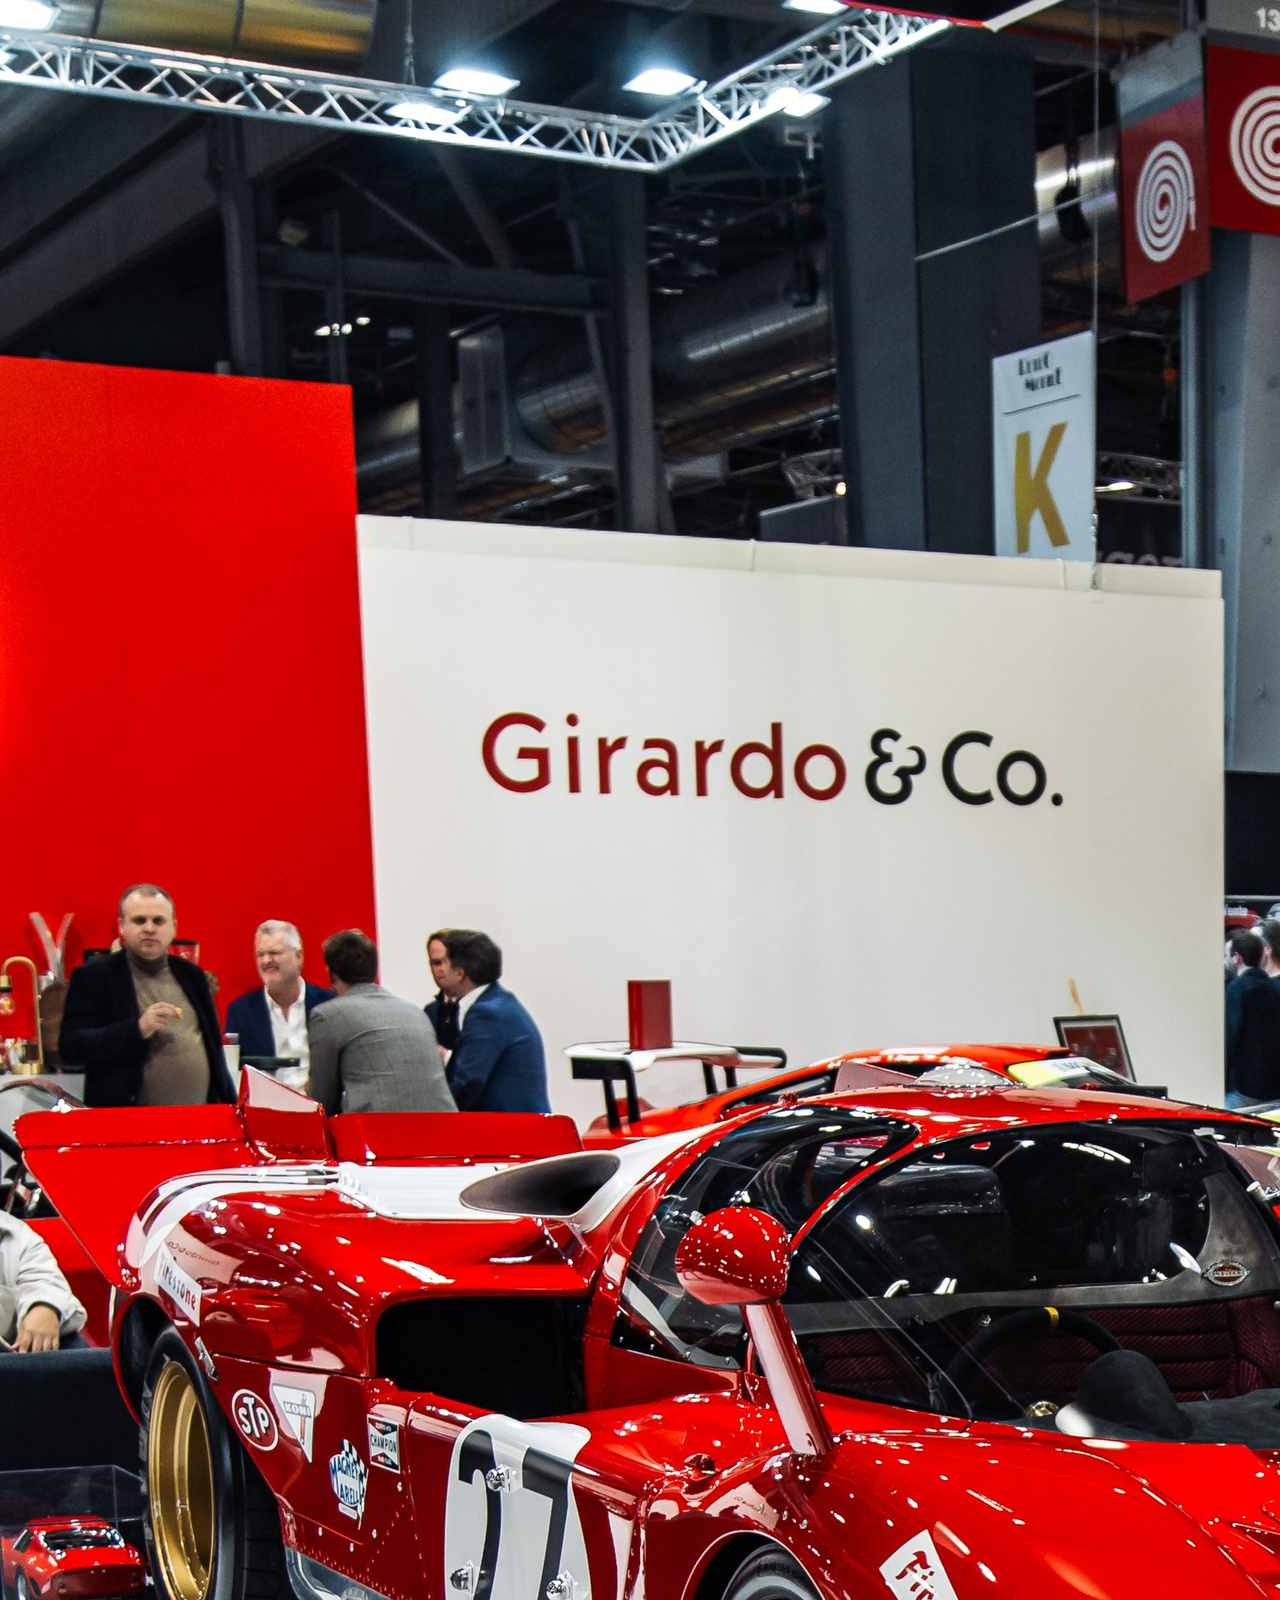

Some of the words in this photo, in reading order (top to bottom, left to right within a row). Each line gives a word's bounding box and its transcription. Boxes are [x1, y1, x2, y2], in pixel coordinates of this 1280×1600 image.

[1013, 420, 1071, 555] K
[238, 1396, 269, 1440] STP
[283, 1401, 312, 1419] KONI
[370, 1433, 397, 1453] CHAMPION
